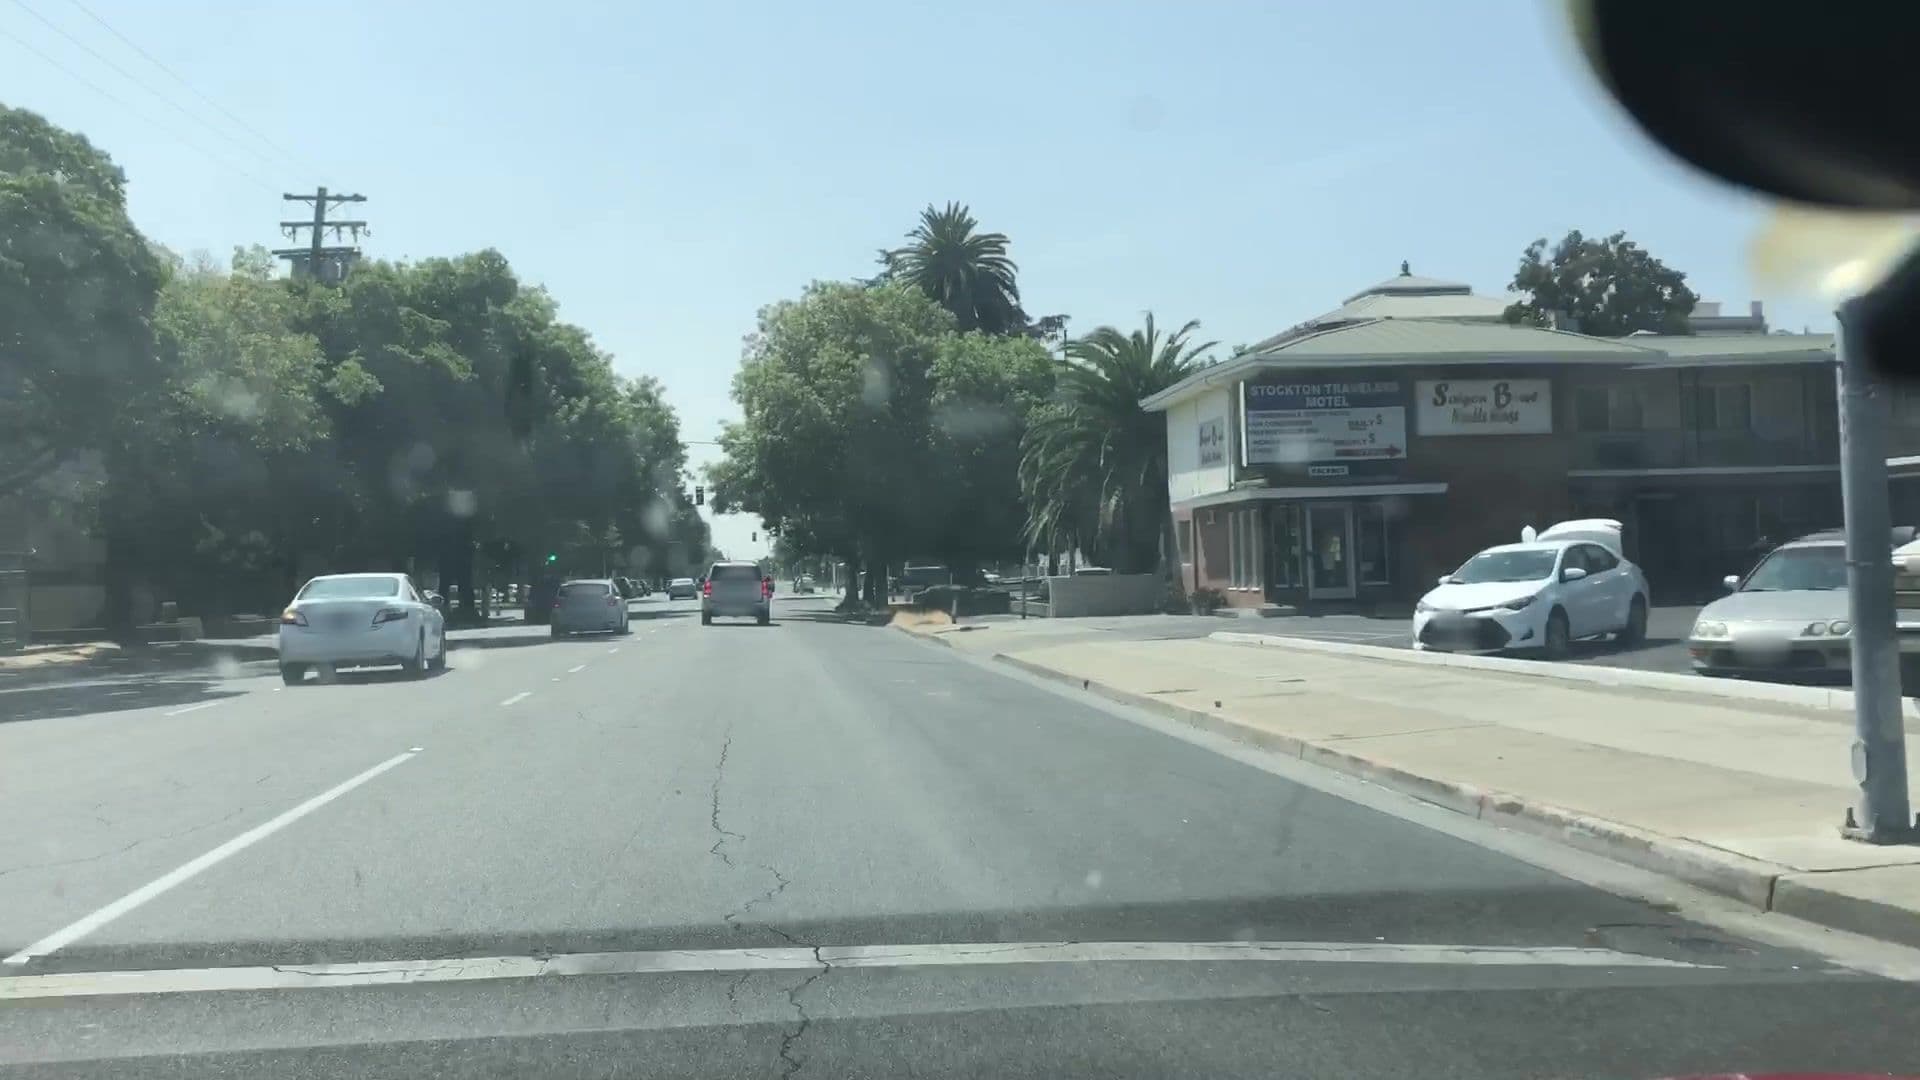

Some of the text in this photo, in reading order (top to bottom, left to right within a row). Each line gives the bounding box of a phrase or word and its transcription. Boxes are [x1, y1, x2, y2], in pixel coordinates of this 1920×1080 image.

[1249, 383, 1320, 396] STOCKTON
[1494, 382, 1539, 409] Bwl
[1305, 395, 1350, 408] MOTEL
